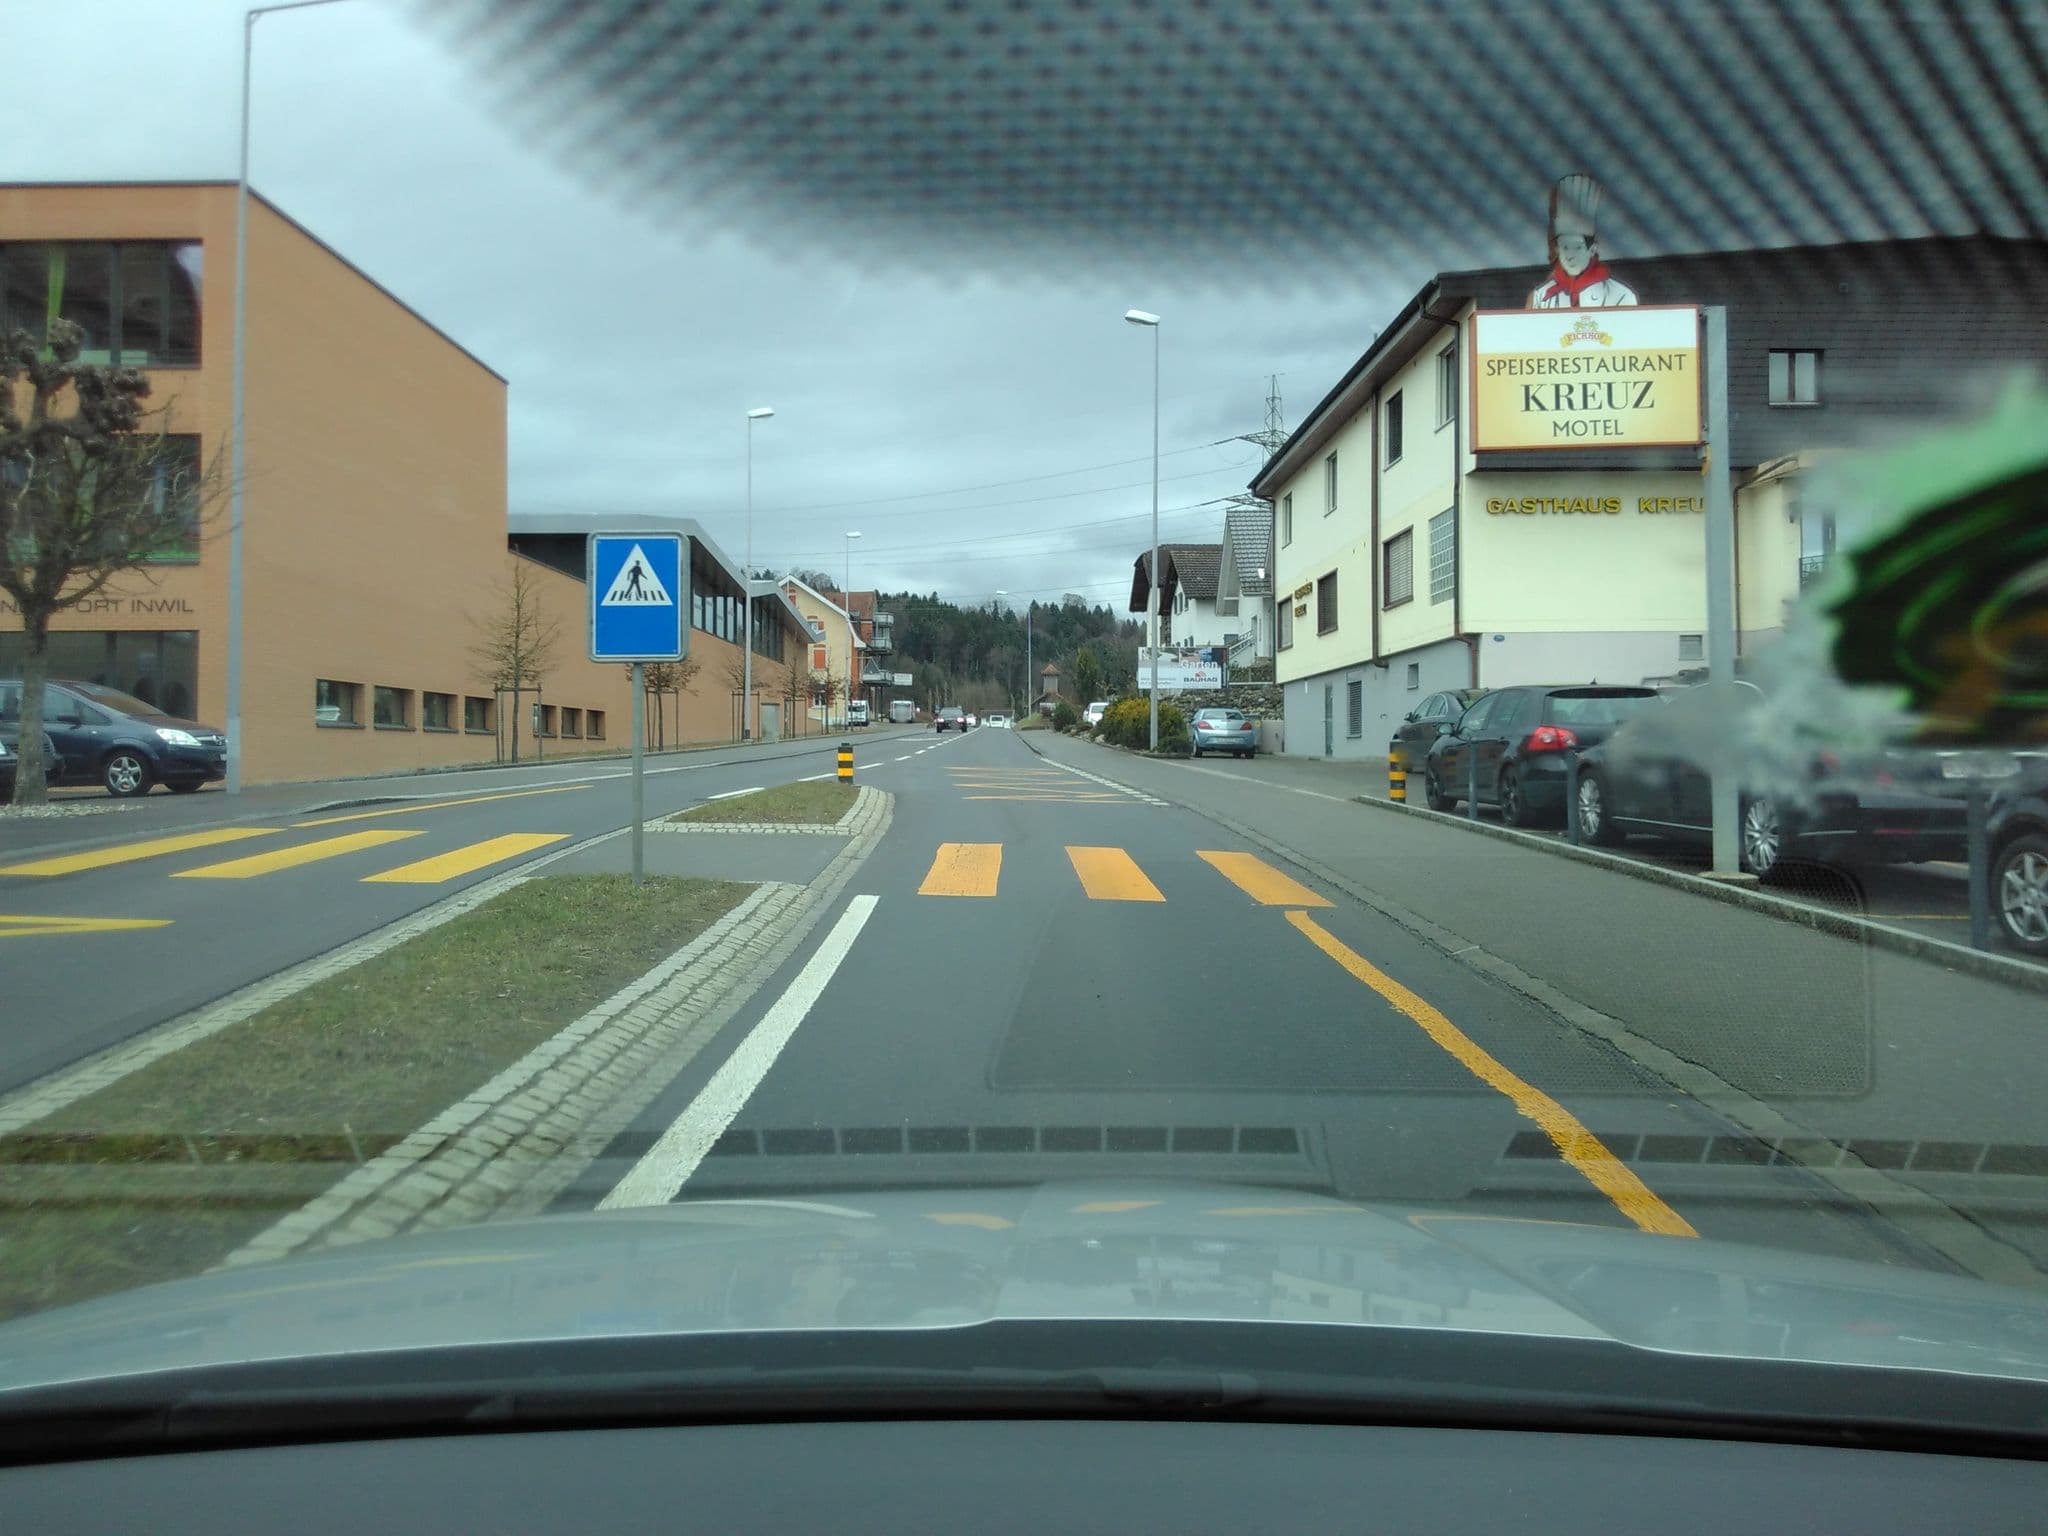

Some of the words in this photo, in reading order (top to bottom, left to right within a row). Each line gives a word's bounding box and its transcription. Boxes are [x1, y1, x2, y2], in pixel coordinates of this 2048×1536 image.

[1486, 354, 1687, 376] SPEISERESTAURANT
[1520, 380, 1655, 413] KREUZ
[1552, 419, 1624, 437] MOTEL
[1487, 497, 1621, 514] GASTHAUS
[1639, 497, 1705, 513] KREU
[131, 599, 194, 613] INWIL
